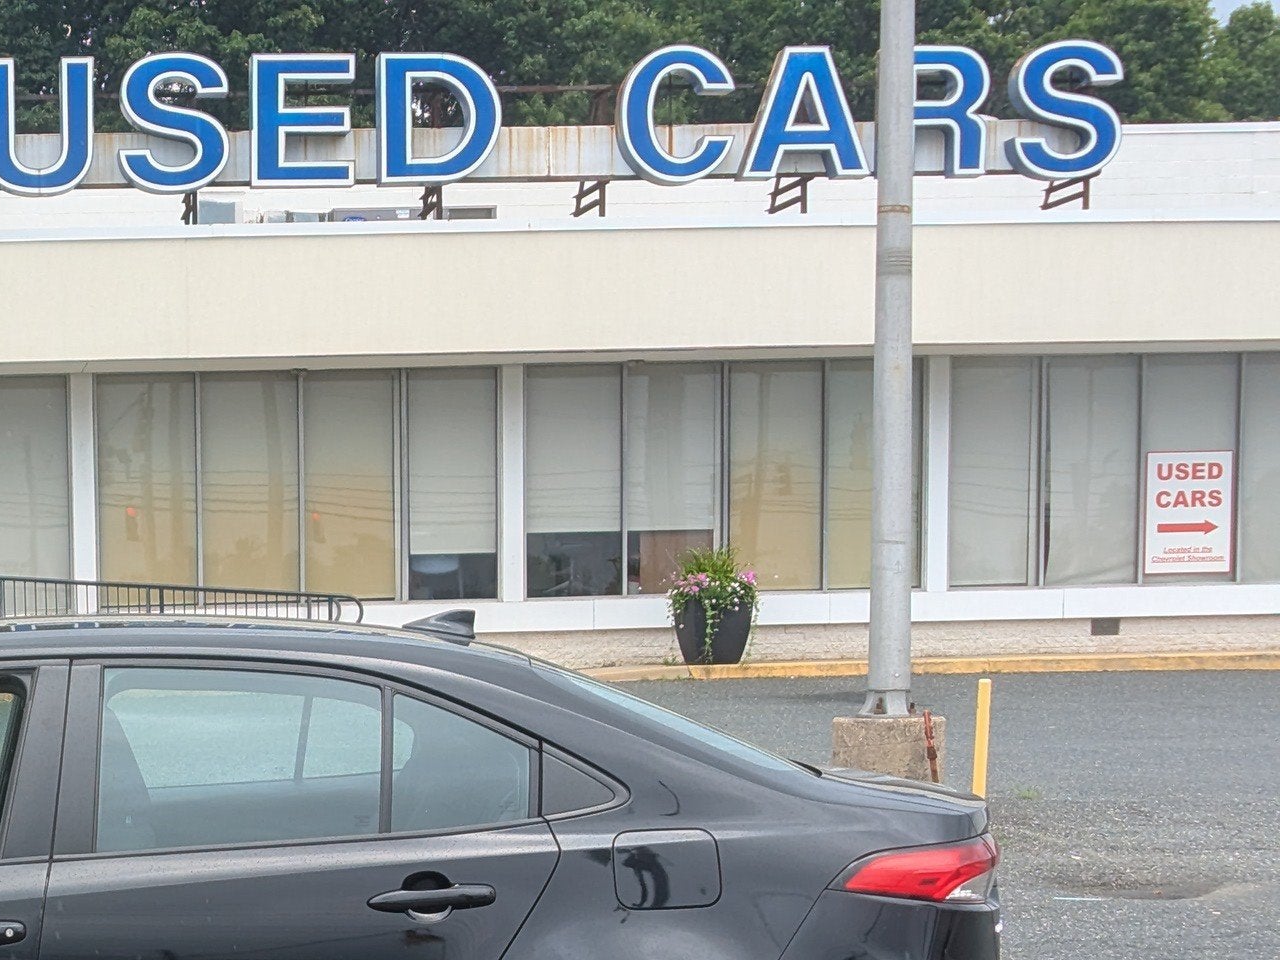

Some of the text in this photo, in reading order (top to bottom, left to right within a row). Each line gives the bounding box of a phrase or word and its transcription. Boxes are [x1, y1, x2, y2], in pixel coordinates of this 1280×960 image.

[615, 39, 1125, 186] CARS
[1157, 462, 1224, 481] USED
[1155, 489, 1223, 509] CARS
